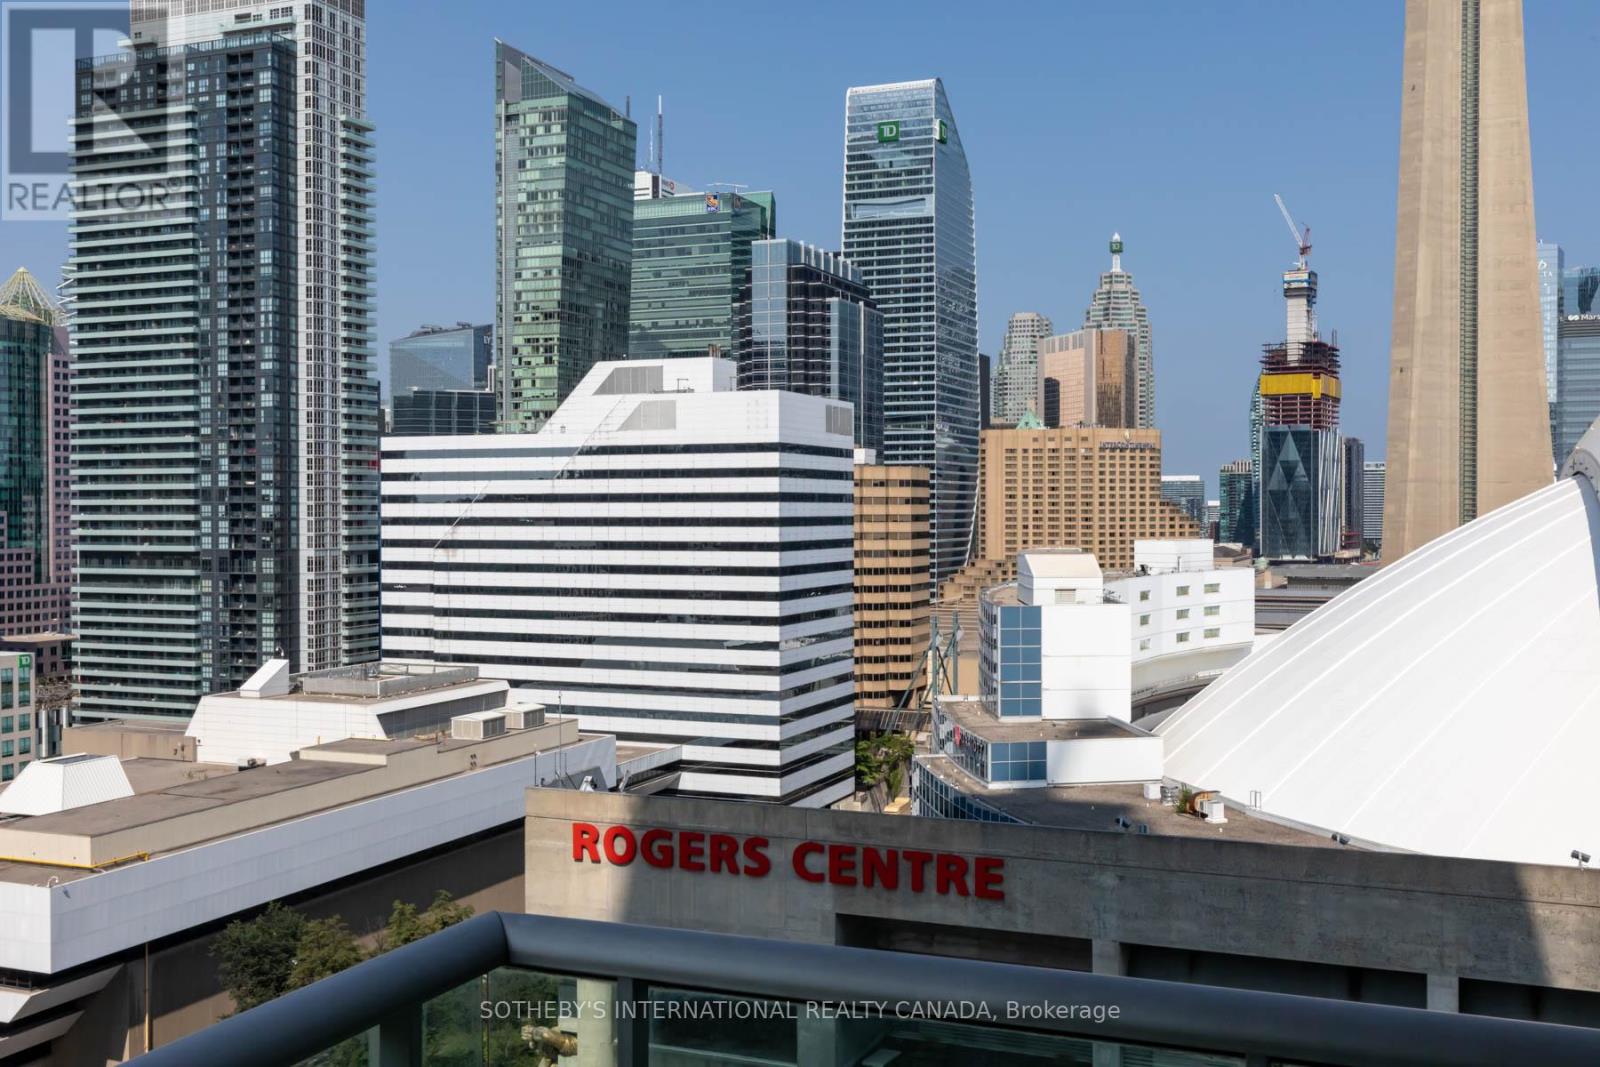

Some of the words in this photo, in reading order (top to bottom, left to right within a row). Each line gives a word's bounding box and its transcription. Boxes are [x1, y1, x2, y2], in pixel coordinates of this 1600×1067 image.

[881, 125, 896, 137] TD
[572, 822, 770, 877] ROGERS
[792, 841, 1006, 899] CENTRE
